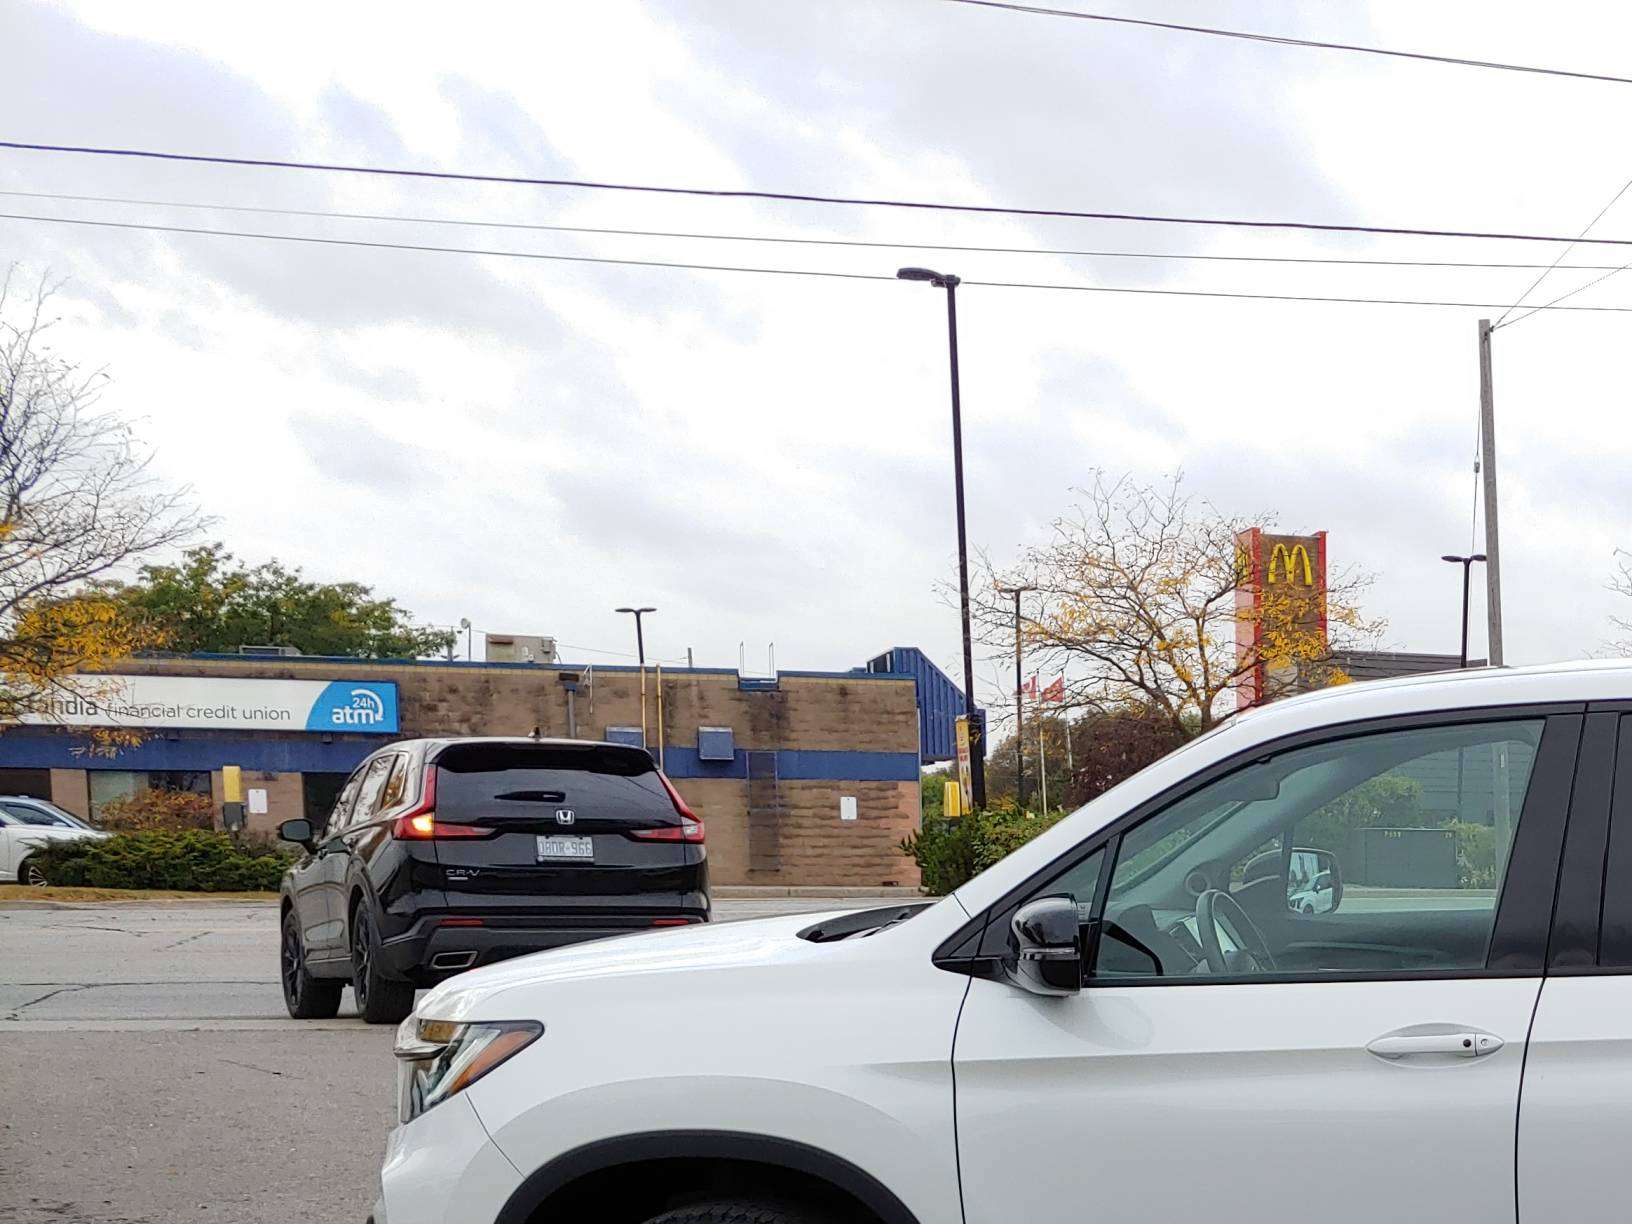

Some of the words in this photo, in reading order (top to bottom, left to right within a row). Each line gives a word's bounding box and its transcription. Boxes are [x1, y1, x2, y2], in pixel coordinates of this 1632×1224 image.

[104, 702, 181, 719] financial
[185, 705, 237, 720] credit
[242, 706, 292, 721] union
[352, 697, 375, 709] 24h
[331, 705, 375, 724] atm
